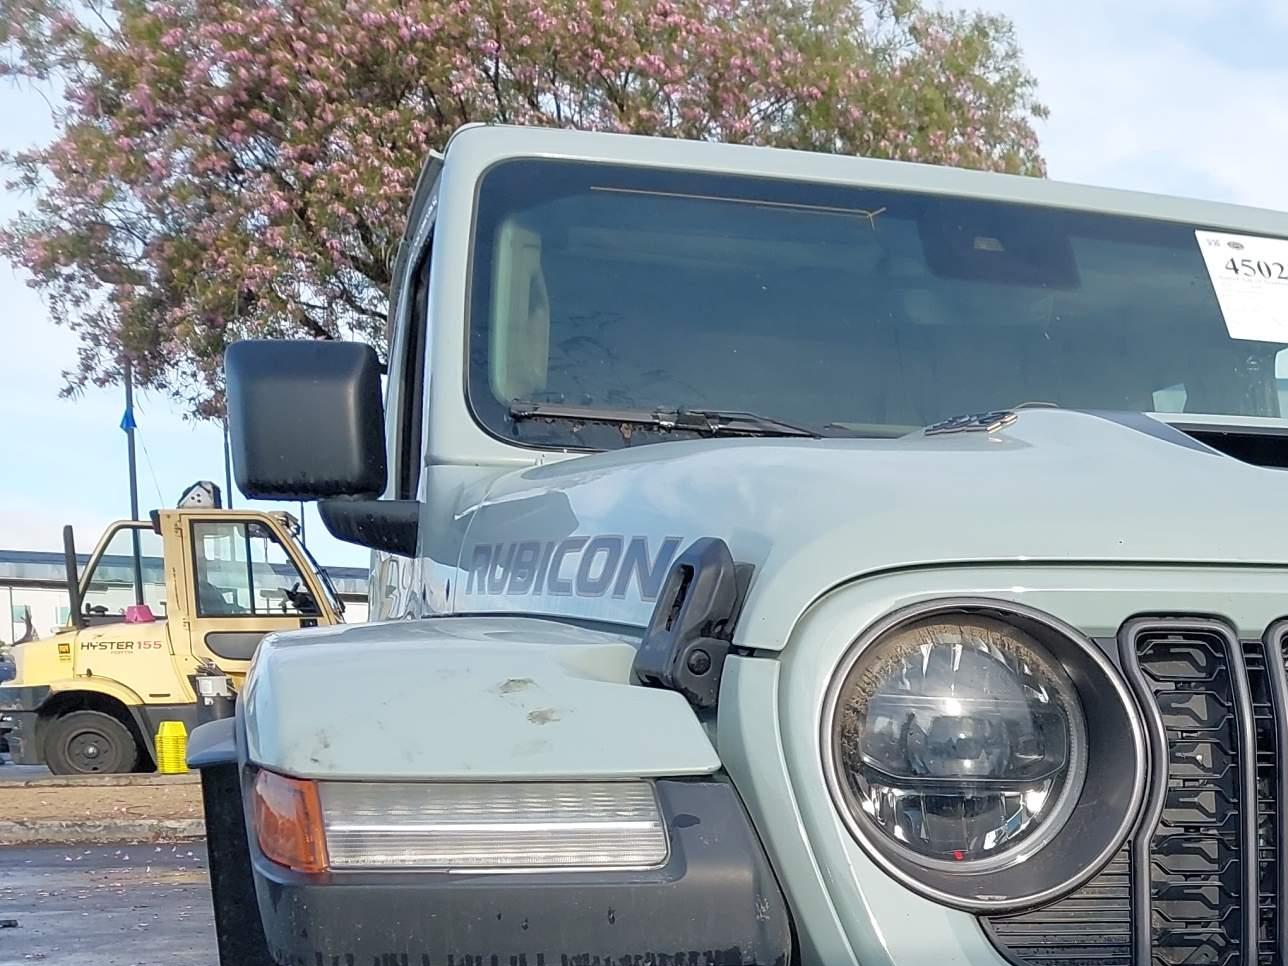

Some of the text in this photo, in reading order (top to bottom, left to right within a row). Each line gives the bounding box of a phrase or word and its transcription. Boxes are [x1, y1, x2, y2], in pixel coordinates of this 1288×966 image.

[464, 534, 684, 602] RUBICON
[80, 640, 163, 651] HYSTER 155
